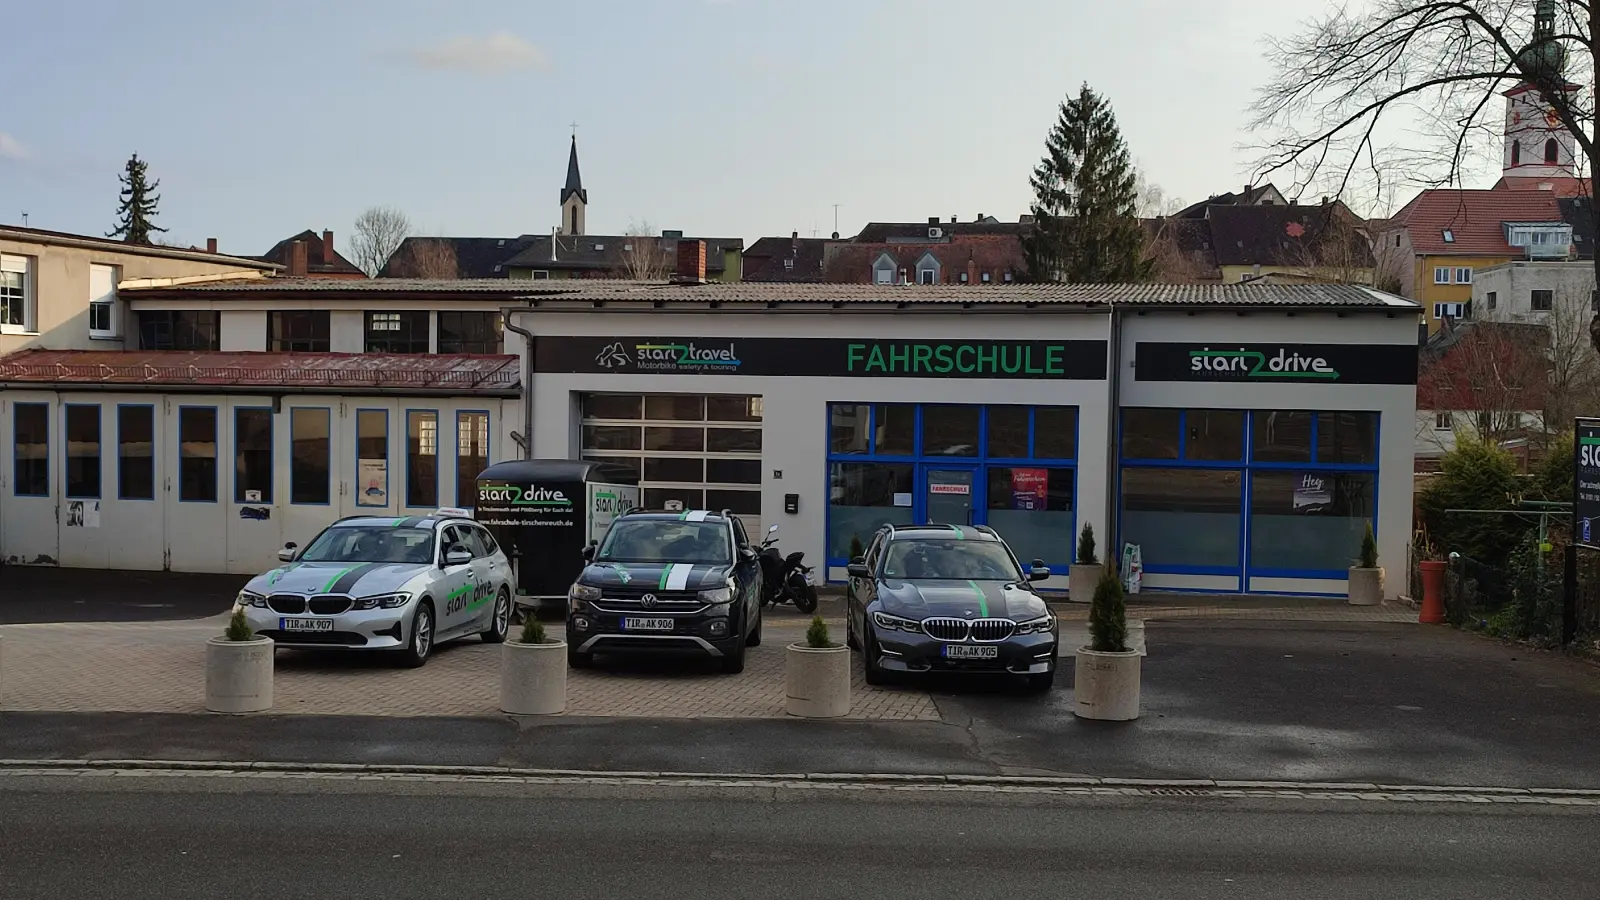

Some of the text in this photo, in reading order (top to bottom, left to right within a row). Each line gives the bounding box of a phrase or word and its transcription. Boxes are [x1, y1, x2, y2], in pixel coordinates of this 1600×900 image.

[847, 344, 1065, 374] FAHRSCHULE
[637, 361, 677, 370] Motorbike
[679, 364, 701, 372] safety
[711, 364, 737, 372] touring
[286, 619, 331, 630] TIR AK 907
[626, 618, 673, 629] TIR AK 906
[948, 645, 996, 656] TIR AK 905
